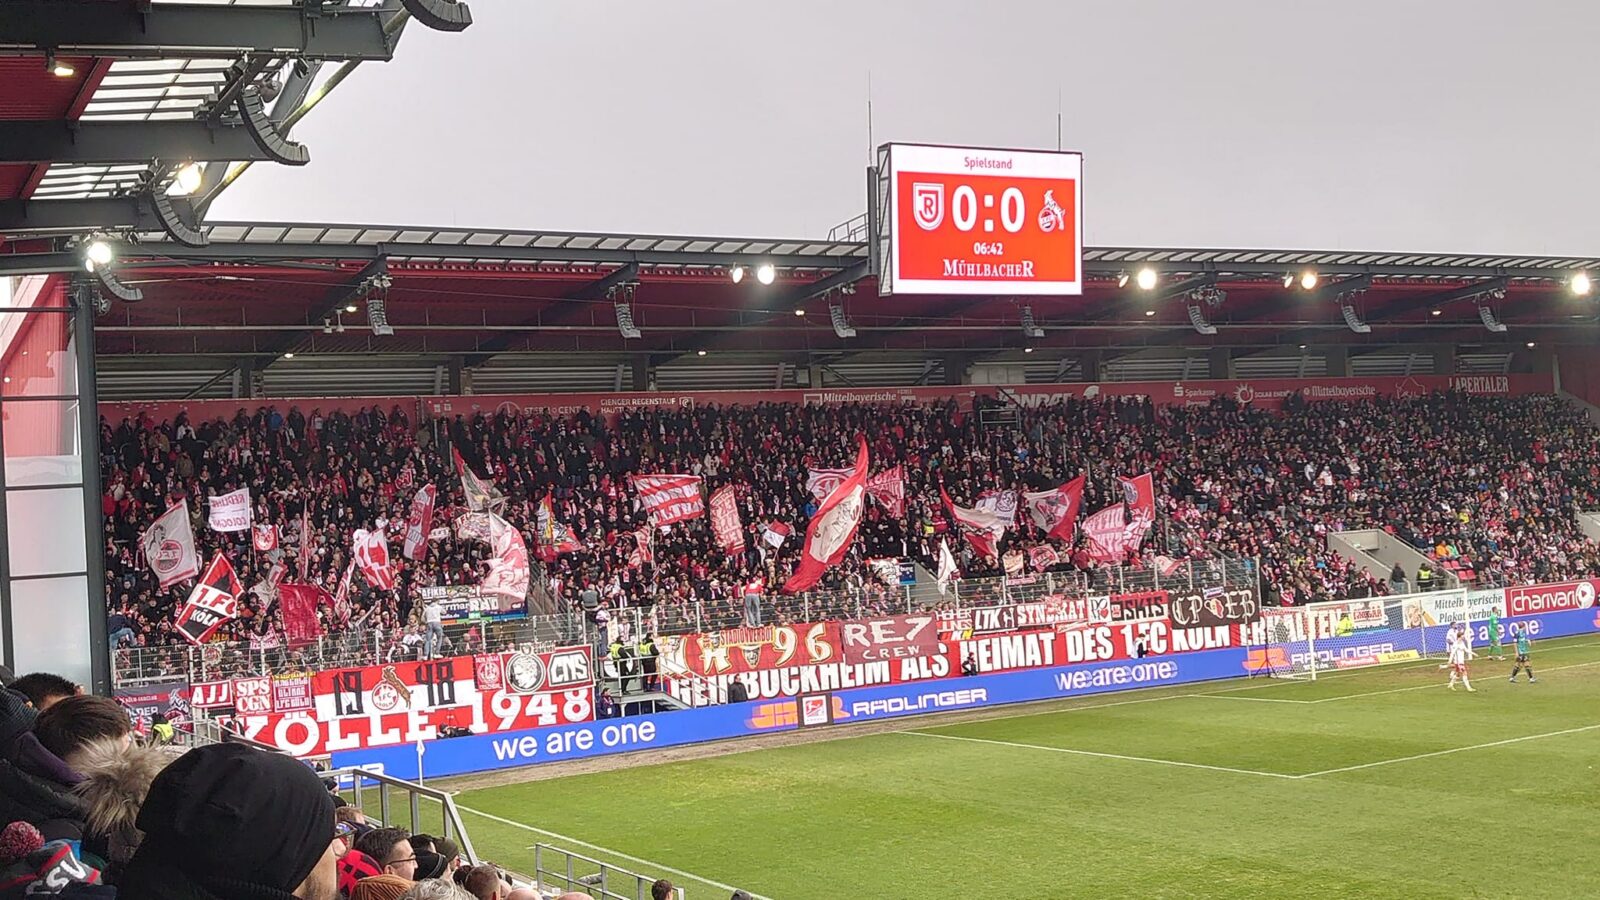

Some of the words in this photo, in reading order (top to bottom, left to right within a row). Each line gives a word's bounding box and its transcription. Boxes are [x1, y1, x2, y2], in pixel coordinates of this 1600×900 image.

[964, 156, 1013, 170] Spielstand
[952, 184, 1026, 234] 0:0
[973, 242, 1004, 256] 06:42
[943, 258, 1035, 278] MÜHLBACHER
[631, 397, 676, 405] REGENSTAUF
[823, 392, 897, 404] Mittelbayerische
[1184, 389, 1216, 398] Sparkasse
[1311, 385, 1376, 399] Mittelbayerische
[194, 587, 235, 615] 1.FC
[1434, 594, 1503, 610] Mittelbyerische
[1513, 590, 1576, 612] charivari
[1439, 609, 1502, 623] Plakaterbug
[862, 645, 920, 661] CREW
[960, 631, 1056, 672] HEIMAT
[1067, 626, 1115, 664] DES
[1054, 670, 1092, 691] we
[1092, 664, 1131, 687] are
[1131, 660, 1178, 682] one
[236, 679, 270, 697] SPS
[467, 688, 591, 735] 1948
[852, 688, 988, 717] RÄDLINGER
[492, 735, 538, 760] we
[545, 729, 594, 754] are
[601, 720, 656, 747] one
